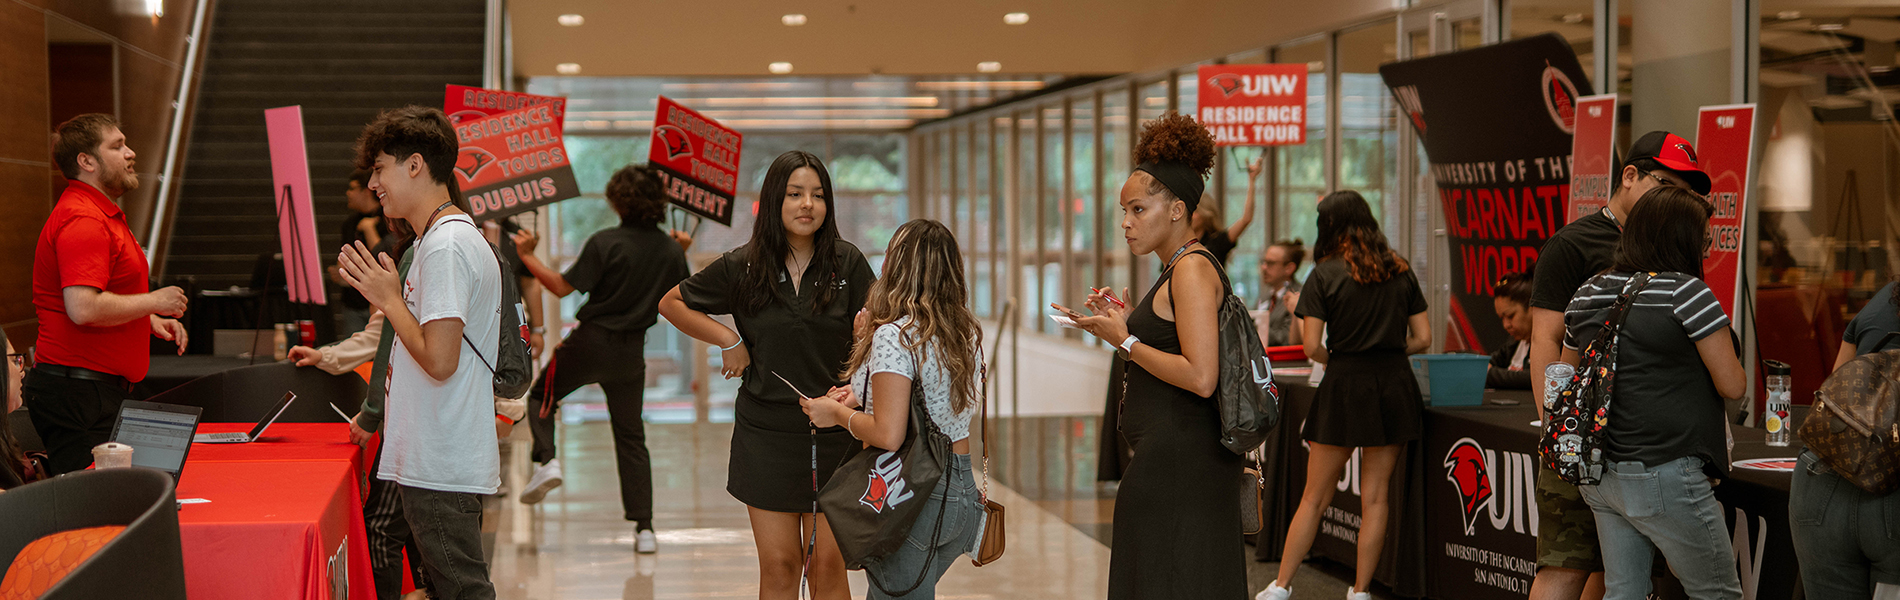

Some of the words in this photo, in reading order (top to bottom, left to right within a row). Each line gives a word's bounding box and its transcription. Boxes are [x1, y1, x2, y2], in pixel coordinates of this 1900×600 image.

[1242, 74, 1298, 97] UIW
[463, 89, 563, 117] RESIDENE
[1202, 105, 1302, 124] RESIDENCE
[456, 105, 553, 143] ESIDENCE
[667, 105, 740, 153] RESIDENCE
[1252, 124, 1300, 143] TOUR
[506, 127, 558, 153] HALL
[498, 147, 564, 177] TOURS
[702, 141, 737, 172] HALL
[690, 157, 735, 191] TOURS
[1504, 159, 1527, 183] OF
[468, 176, 557, 216] DUBUIS
[657, 169, 728, 218] LEMENT
[1573, 173, 1608, 200] CAMPUS
[875, 451, 915, 509] UIW
[1479, 549, 1488, 565] OF
[1489, 551, 1502, 568] THE
[1474, 567, 1487, 584] SAN
